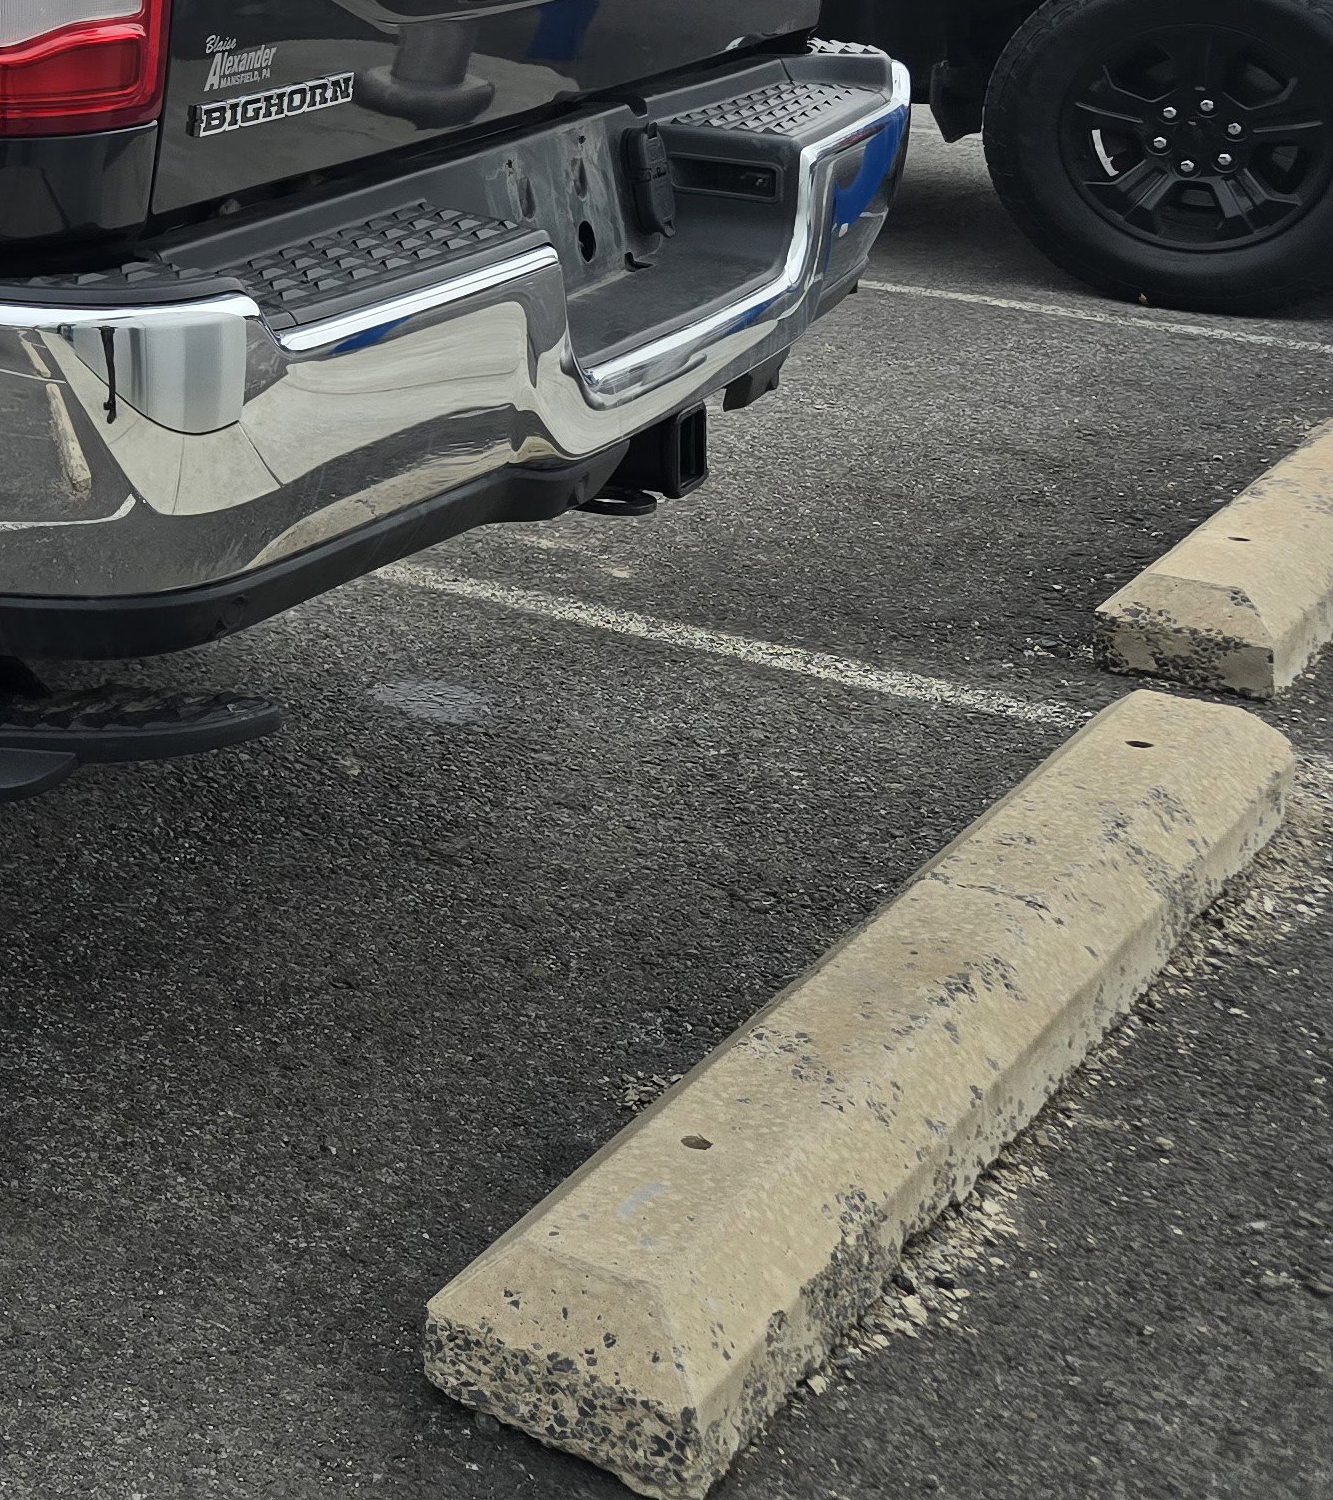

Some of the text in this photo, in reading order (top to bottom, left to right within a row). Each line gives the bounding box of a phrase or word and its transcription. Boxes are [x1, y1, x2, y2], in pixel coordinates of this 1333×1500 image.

[205, 34, 237, 54] Blaise
[203, 44, 278, 92] Alexander
[219, 67, 271, 89] MANSFIELD, PA
[199, 72, 355, 137] BIGHORN
